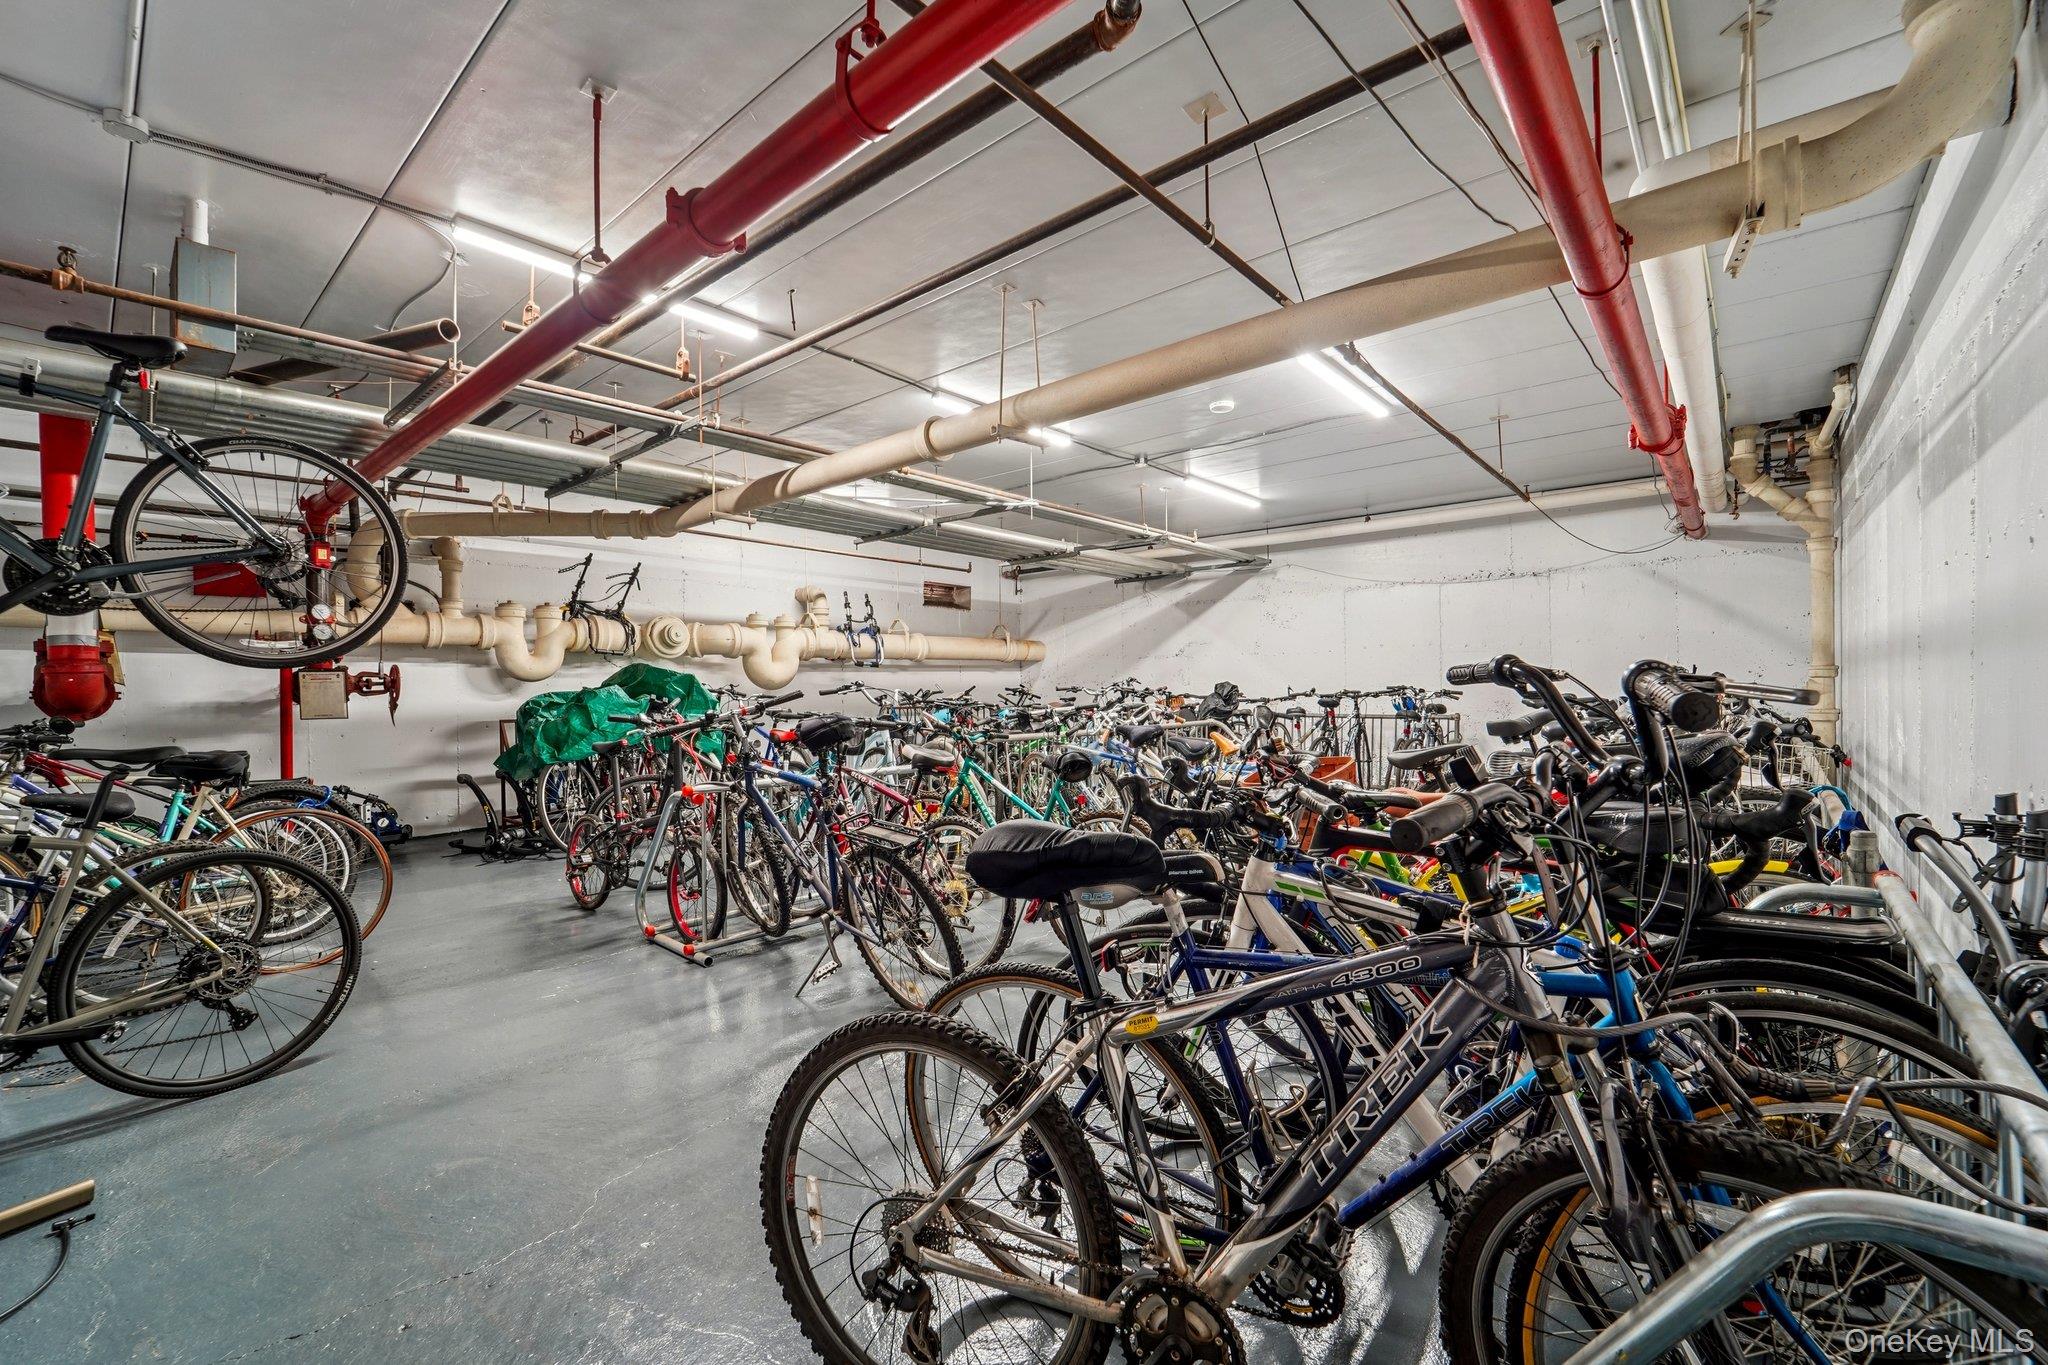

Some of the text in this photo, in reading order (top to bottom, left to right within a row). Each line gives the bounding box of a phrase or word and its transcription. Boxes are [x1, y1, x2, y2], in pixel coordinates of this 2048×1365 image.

[1331, 956, 1421, 988] 4300
[1277, 981, 1327, 997] ALPHA
[1129, 1016, 1154, 1026] PERMIT
[1301, 1008, 1452, 1187] TREK
[1440, 1075, 1545, 1156] TREK
